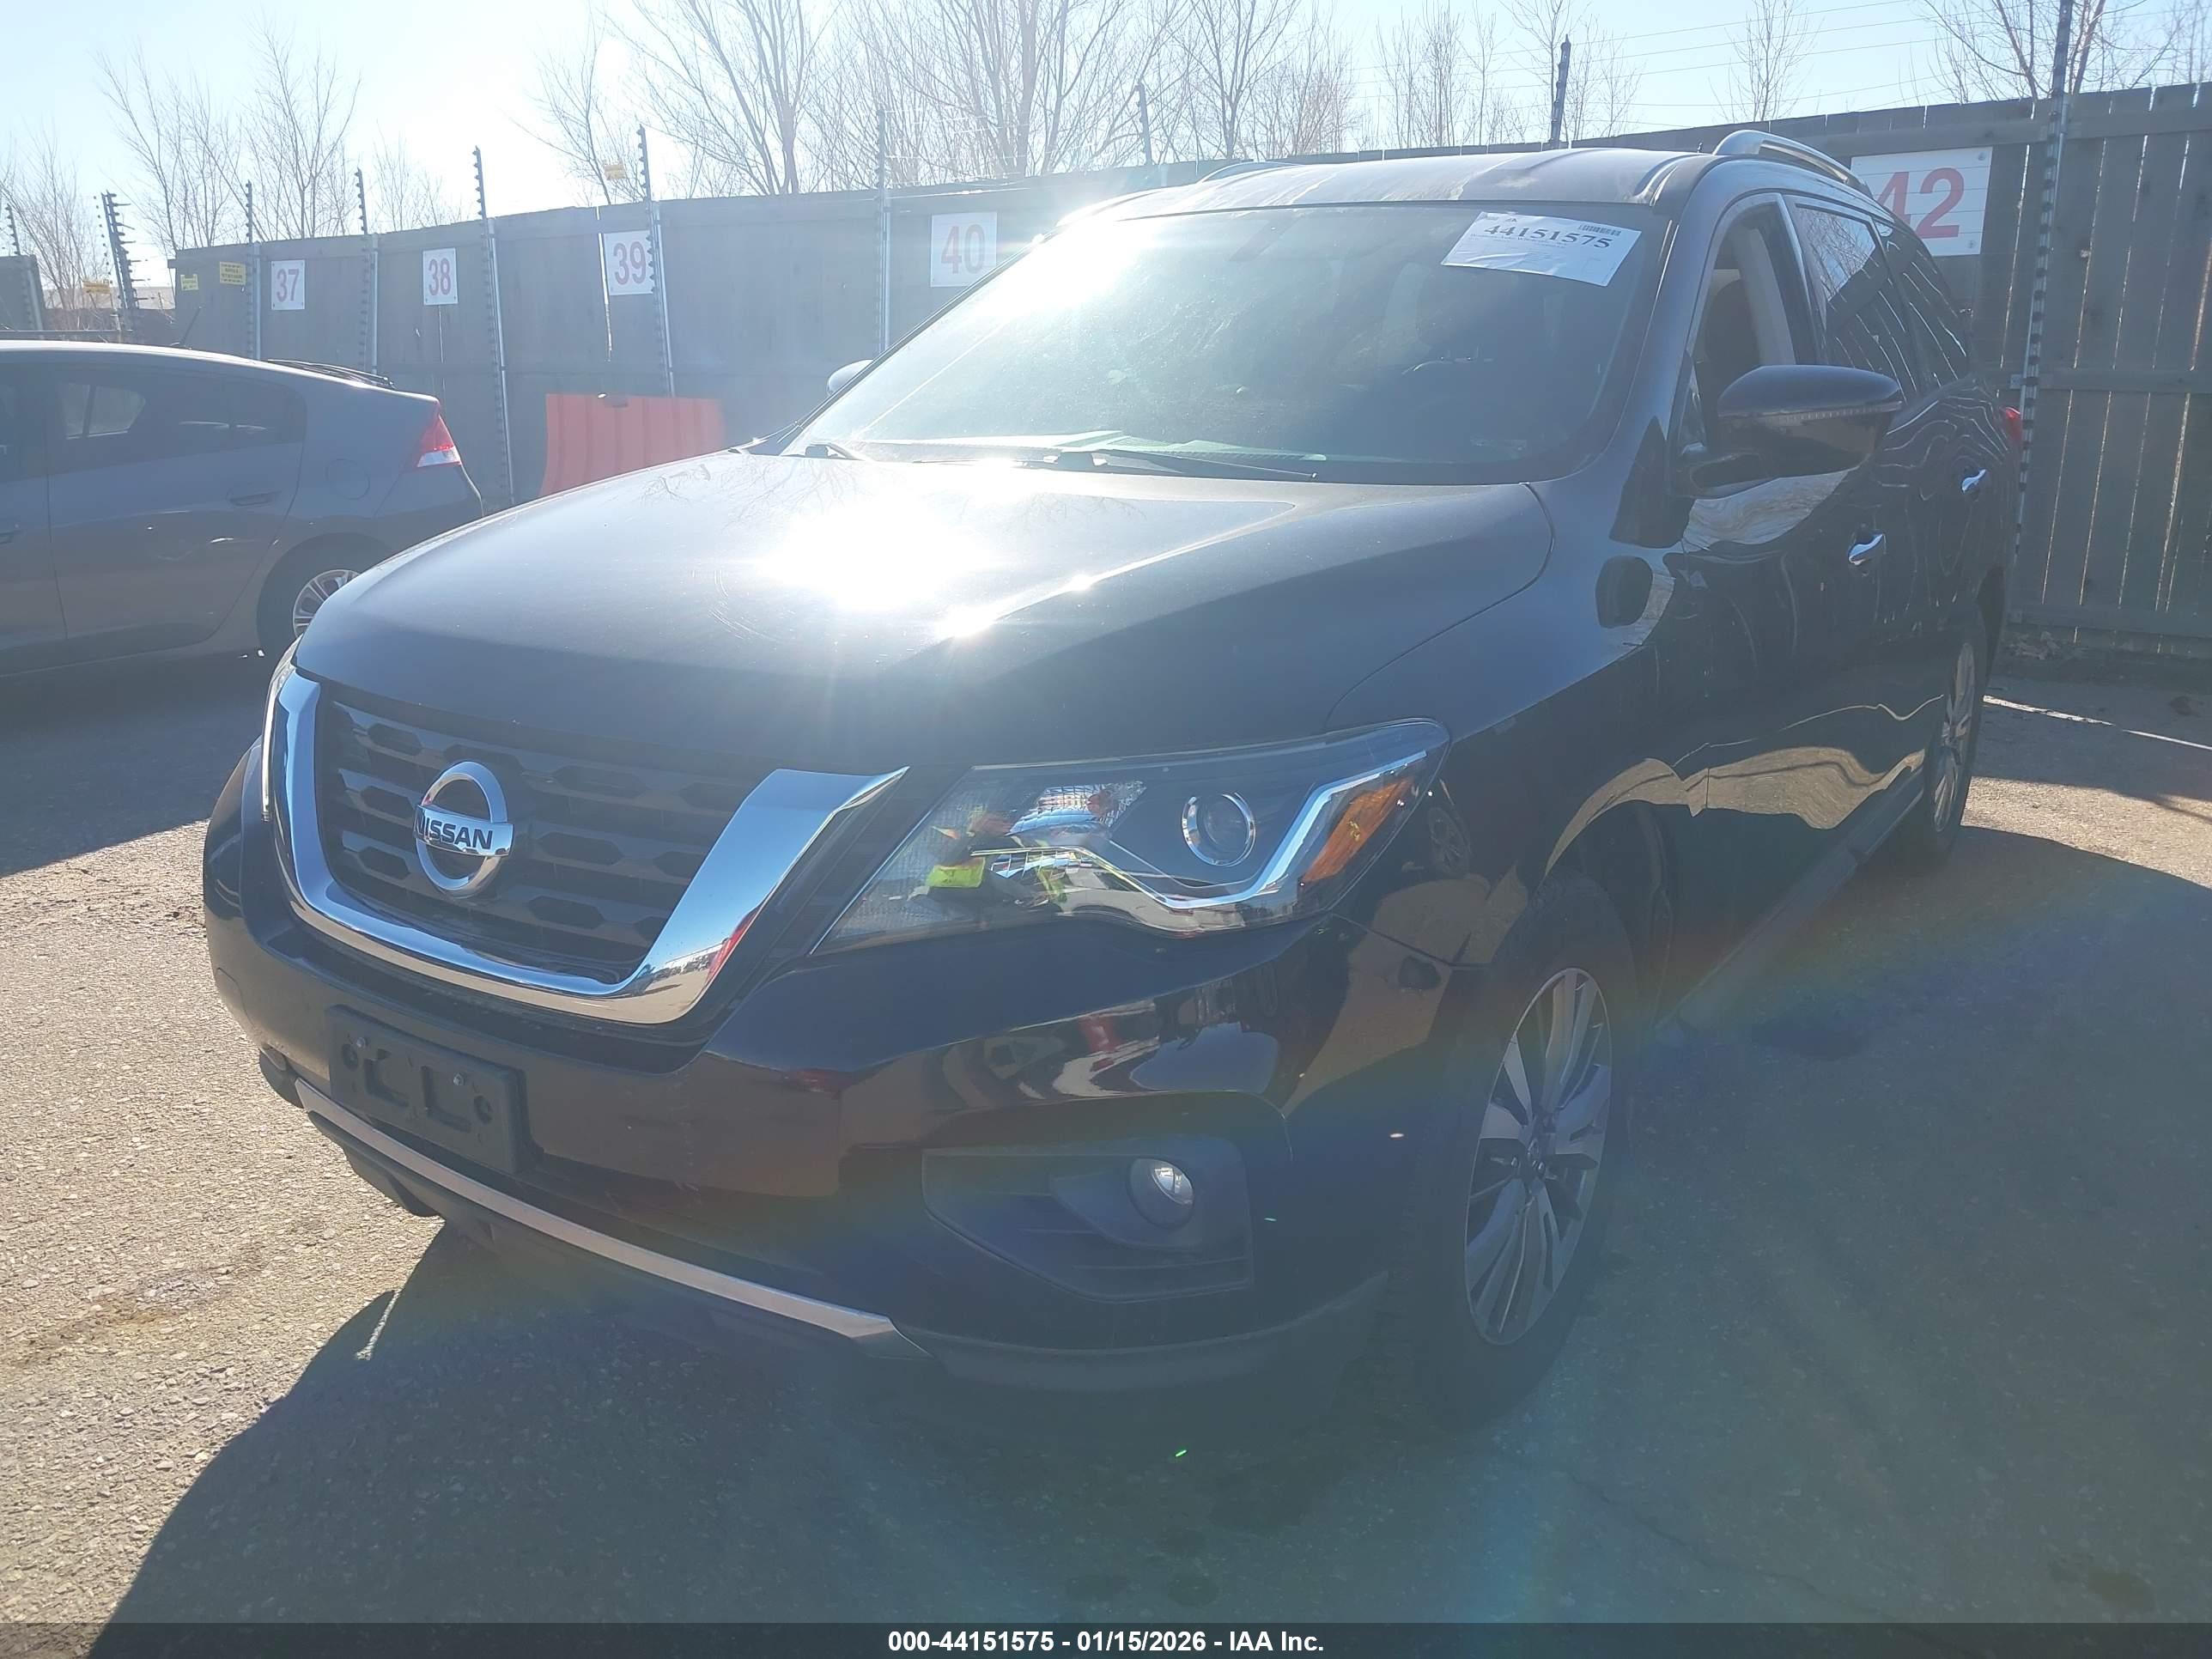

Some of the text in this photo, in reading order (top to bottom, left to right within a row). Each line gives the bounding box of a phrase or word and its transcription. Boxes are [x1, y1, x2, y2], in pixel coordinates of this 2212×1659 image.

[1875, 167, 1965, 240] 42
[940, 223, 986, 275] 40
[1484, 224, 1613, 249] 44151575
[428, 258, 452, 296] 38
[613, 240, 647, 285] 39
[276, 268, 300, 302] 37
[416, 808, 493, 850] NISSAN
